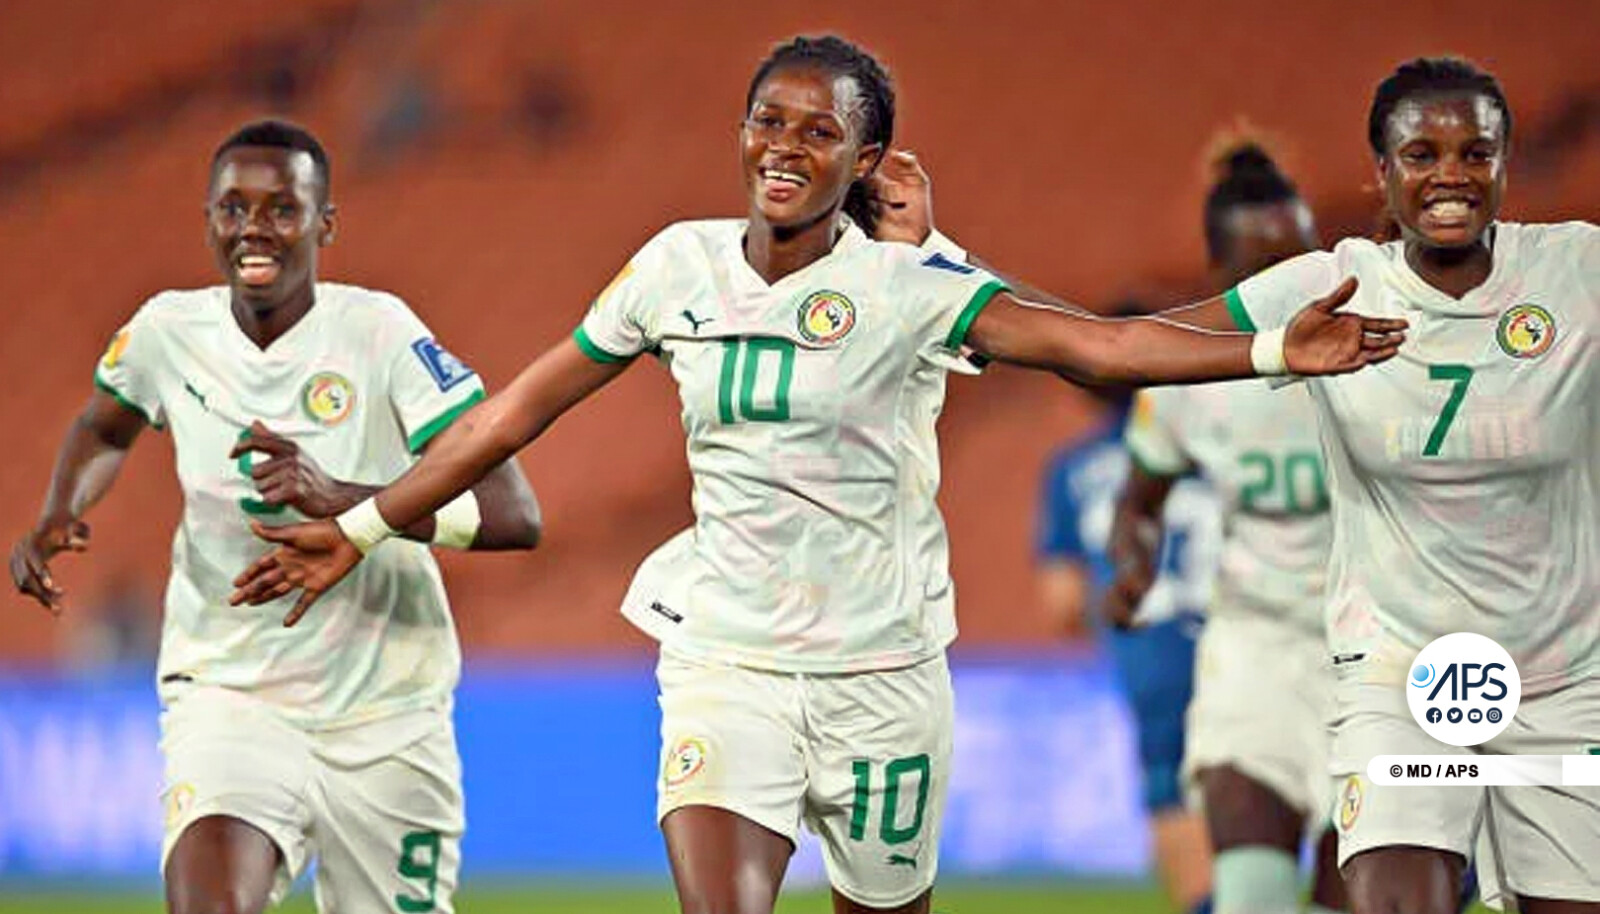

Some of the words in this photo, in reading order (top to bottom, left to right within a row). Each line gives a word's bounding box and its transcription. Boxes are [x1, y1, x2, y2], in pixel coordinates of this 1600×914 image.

[718, 335, 796, 424] 10
[1422, 364, 1475, 456] 7
[1238, 452, 1328, 515] 20
[850, 753, 931, 845] 10
[395, 831, 442, 913] 9
